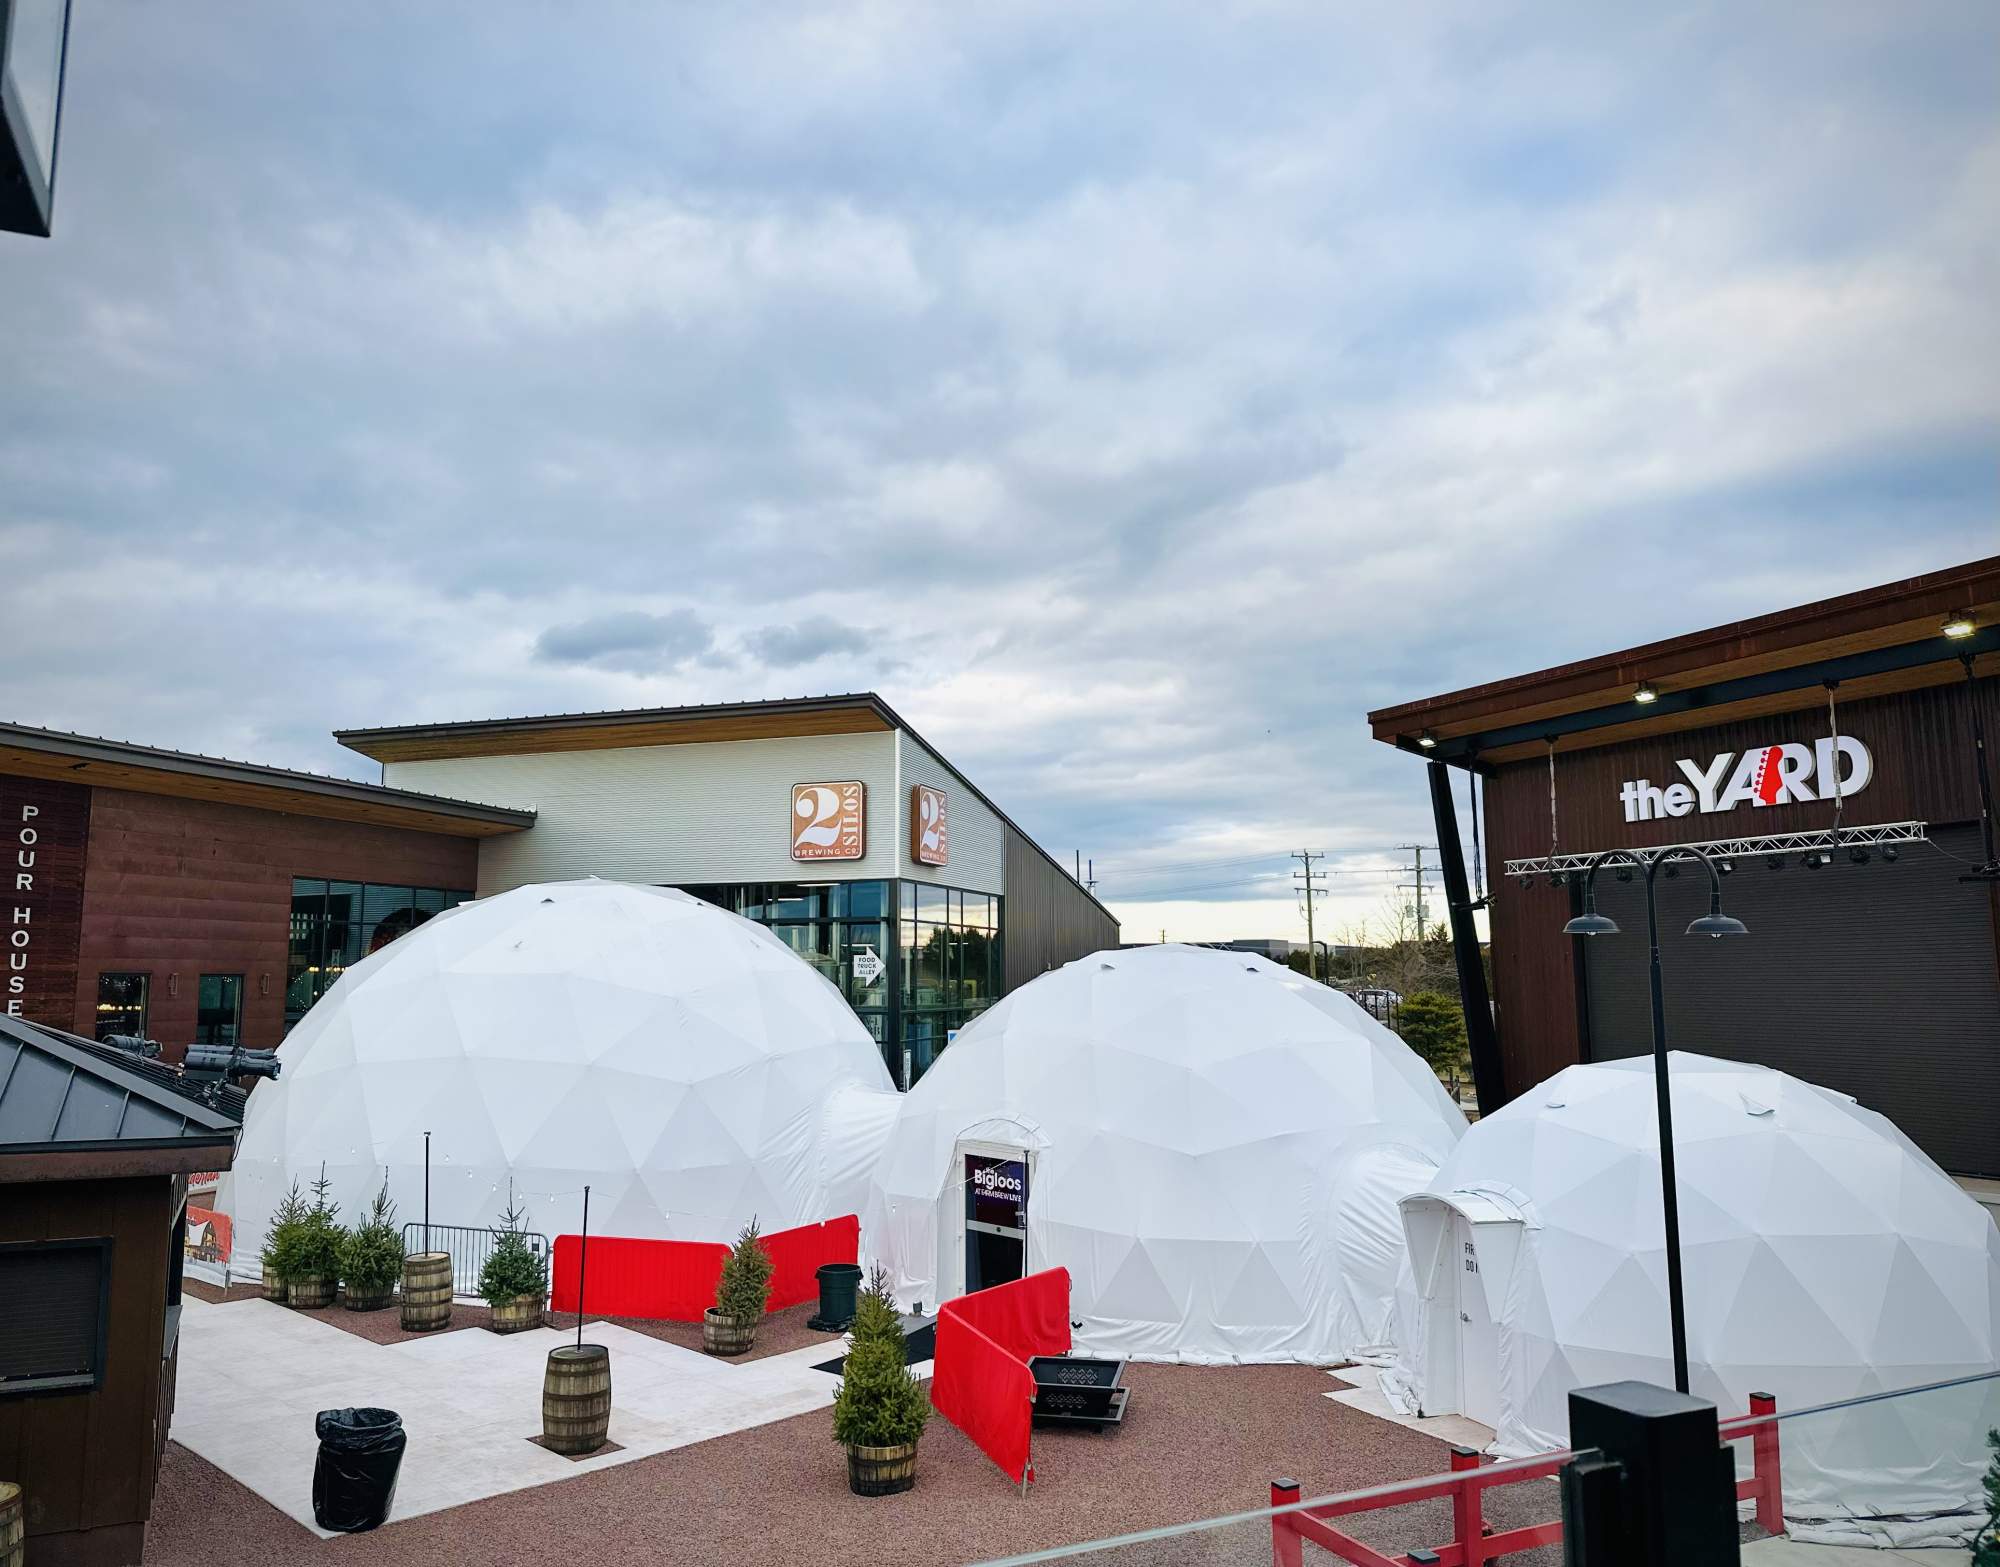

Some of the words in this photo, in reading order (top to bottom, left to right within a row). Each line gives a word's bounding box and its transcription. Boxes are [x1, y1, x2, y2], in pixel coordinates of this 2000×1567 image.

[794, 787, 842, 848] 2
[843, 785, 859, 846] SILOS
[921, 791, 940, 851] 2
[939, 796, 947, 853] SILOS
[15, 805, 39, 891] POUR
[794, 848, 841, 857] BREWING
[7, 907, 31, 1017] HOUSE
[974, 1169, 1022, 1190] Bigloos
[1009, 1193, 1022, 1202] LIVE
